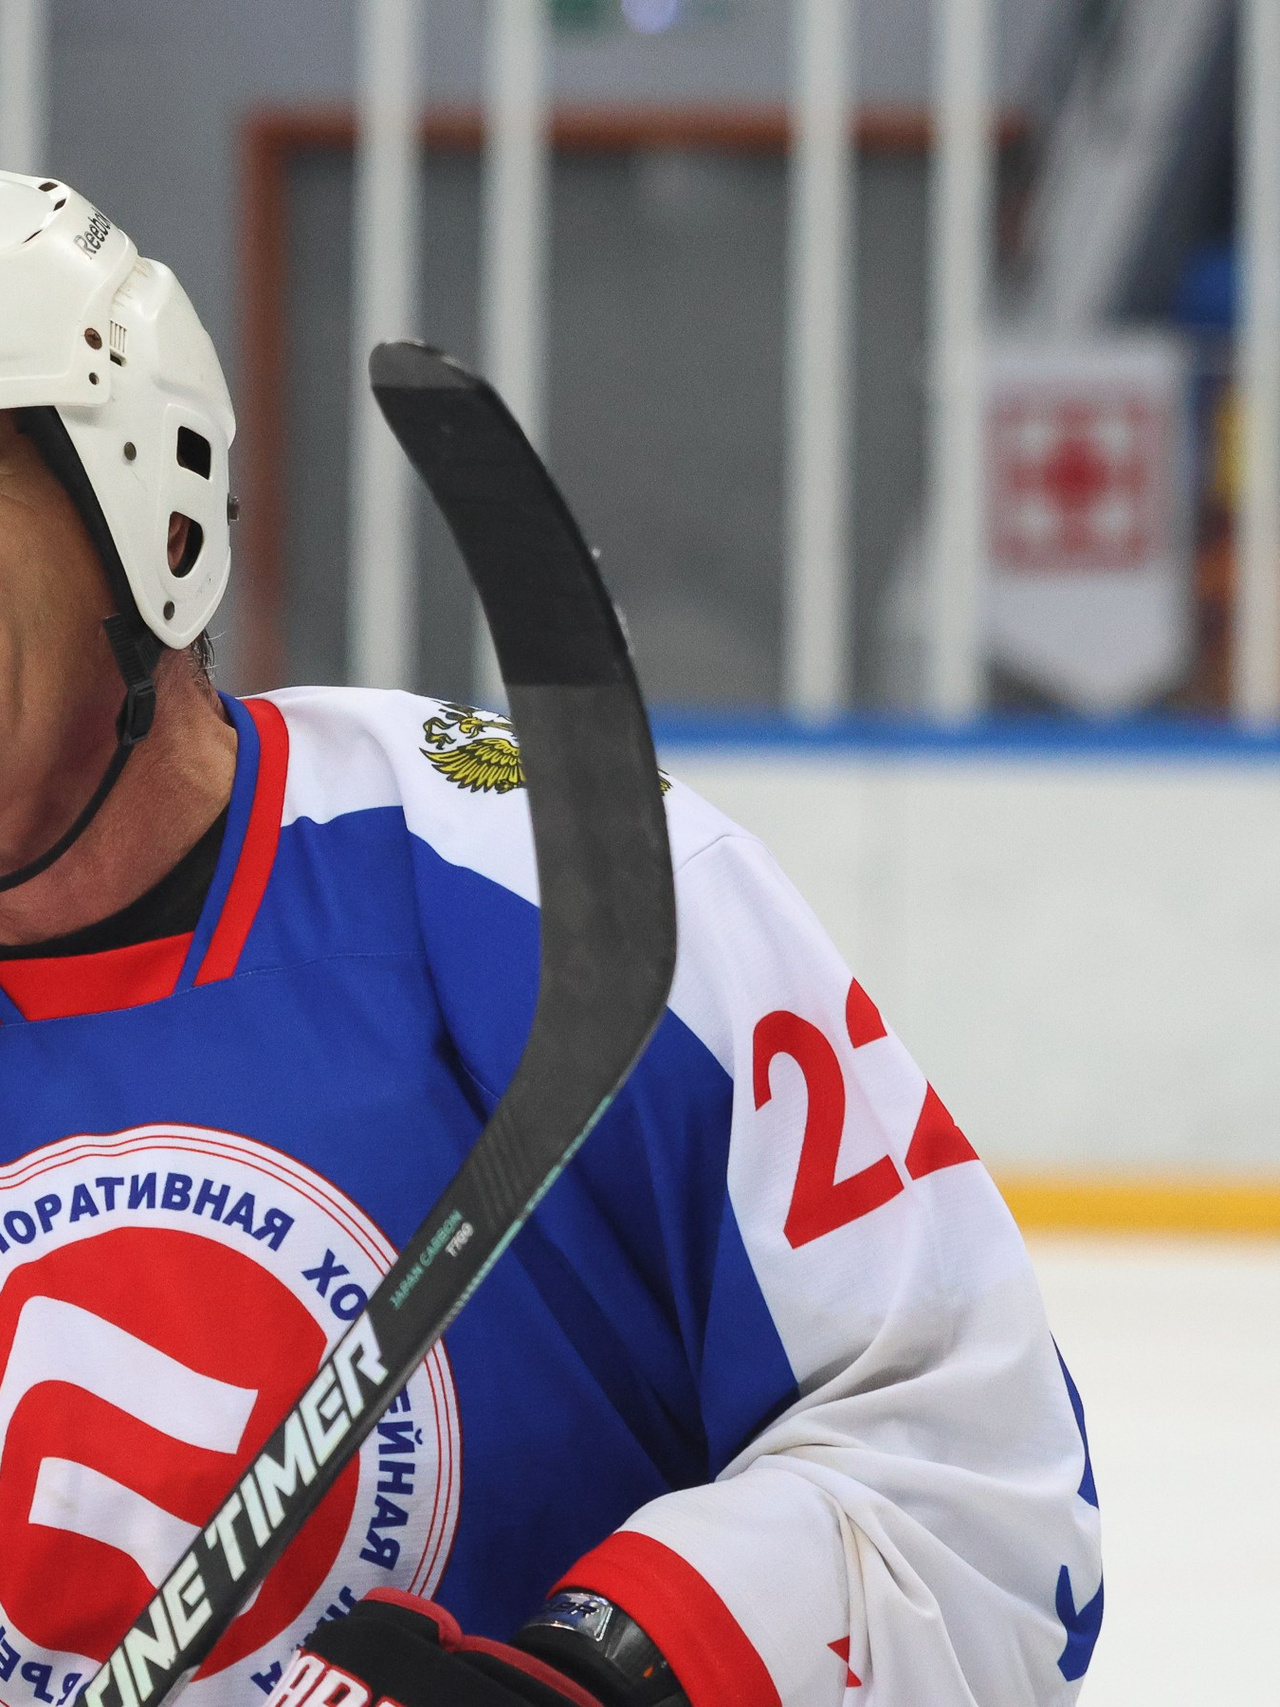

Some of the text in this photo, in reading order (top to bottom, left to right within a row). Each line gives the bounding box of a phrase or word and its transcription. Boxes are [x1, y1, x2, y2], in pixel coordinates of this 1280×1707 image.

[420, 1209, 464, 1267] CARBON
[204, 1309, 388, 1583] TIMER
[300, 1248, 423, 1571] ХОЙНАЯ
